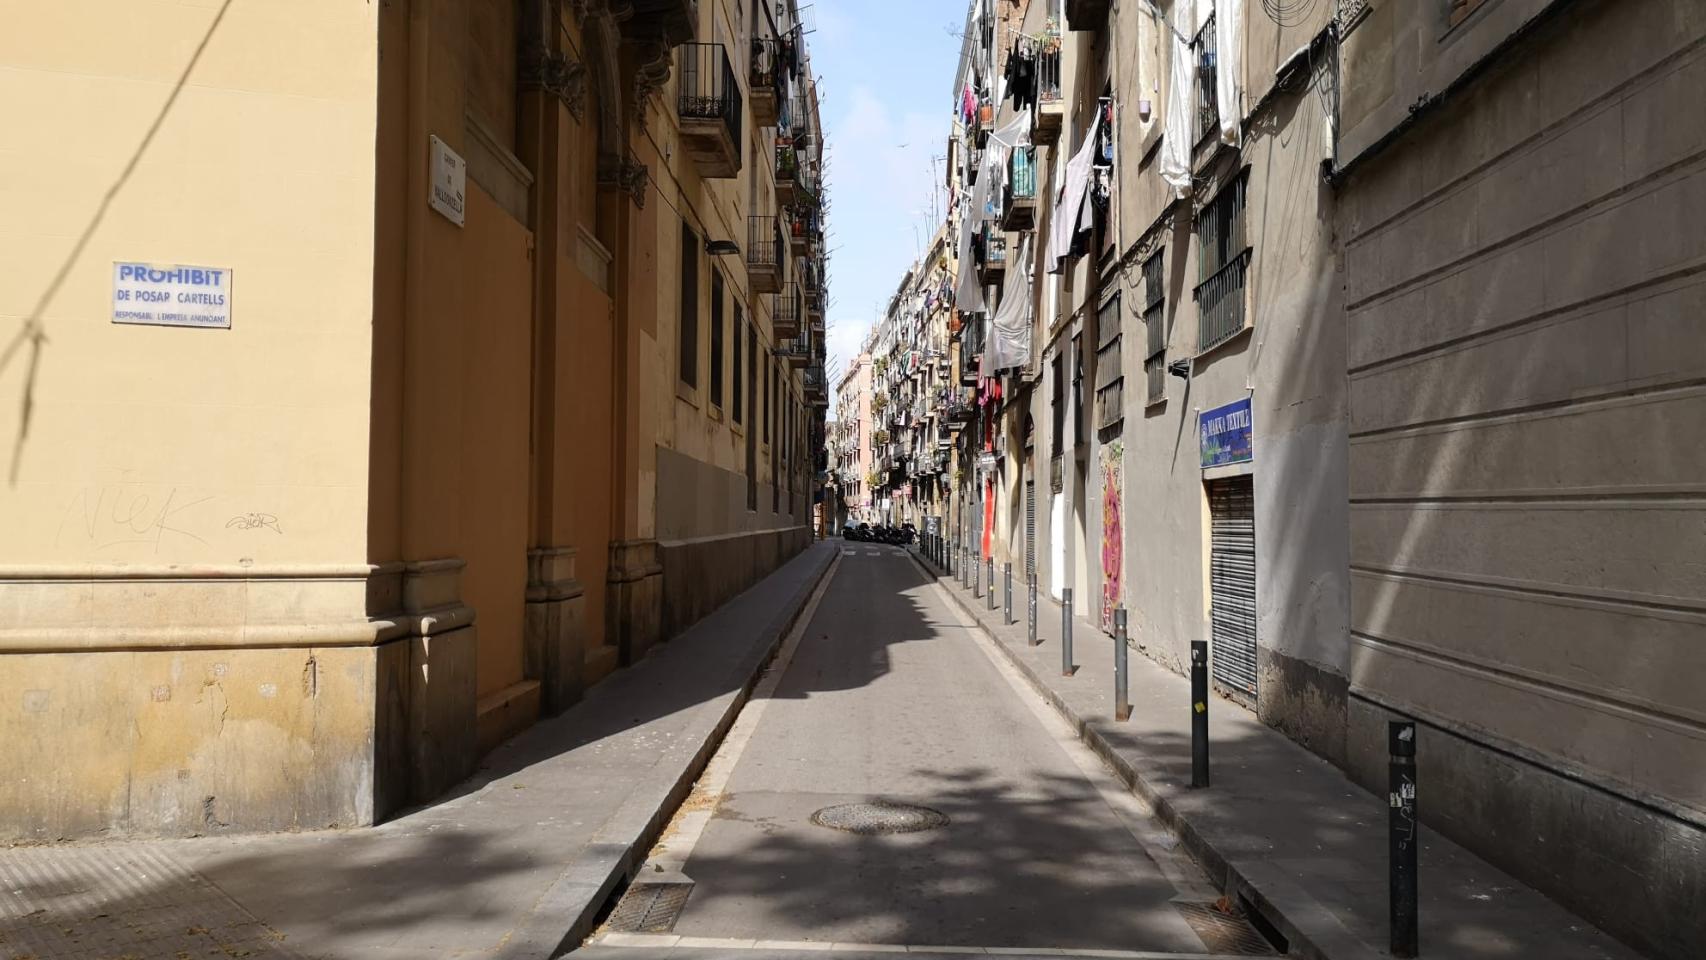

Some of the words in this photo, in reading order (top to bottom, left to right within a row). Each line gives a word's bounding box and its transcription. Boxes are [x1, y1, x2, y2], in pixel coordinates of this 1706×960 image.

[120, 265, 222, 286] PROHIBIT
[117, 289, 130, 301] DE
[135, 290, 170, 303] POSAR
[177, 292, 225, 306] CARTELLS
